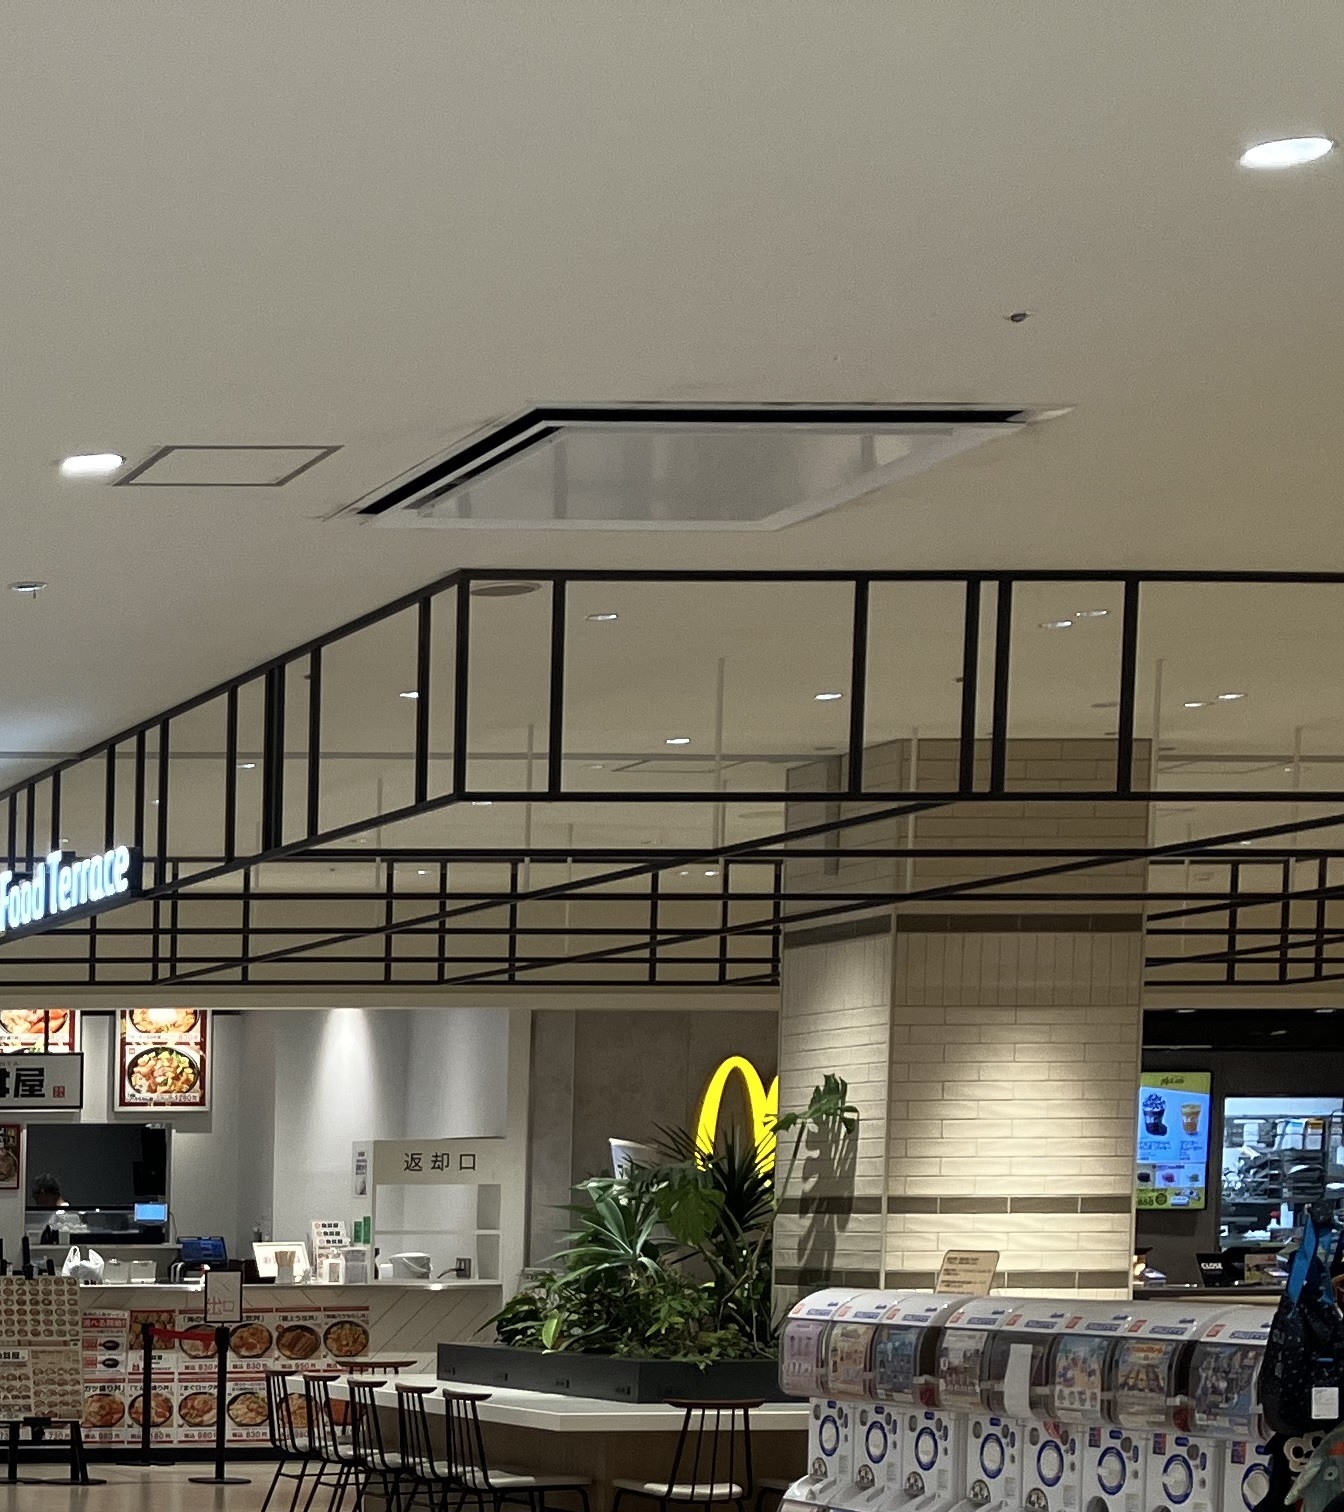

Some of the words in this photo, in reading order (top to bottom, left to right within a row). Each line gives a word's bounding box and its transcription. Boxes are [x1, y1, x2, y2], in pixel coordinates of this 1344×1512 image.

[46, 846, 130, 912] Terrace
[403, 1152, 476, 1172] 返却口
